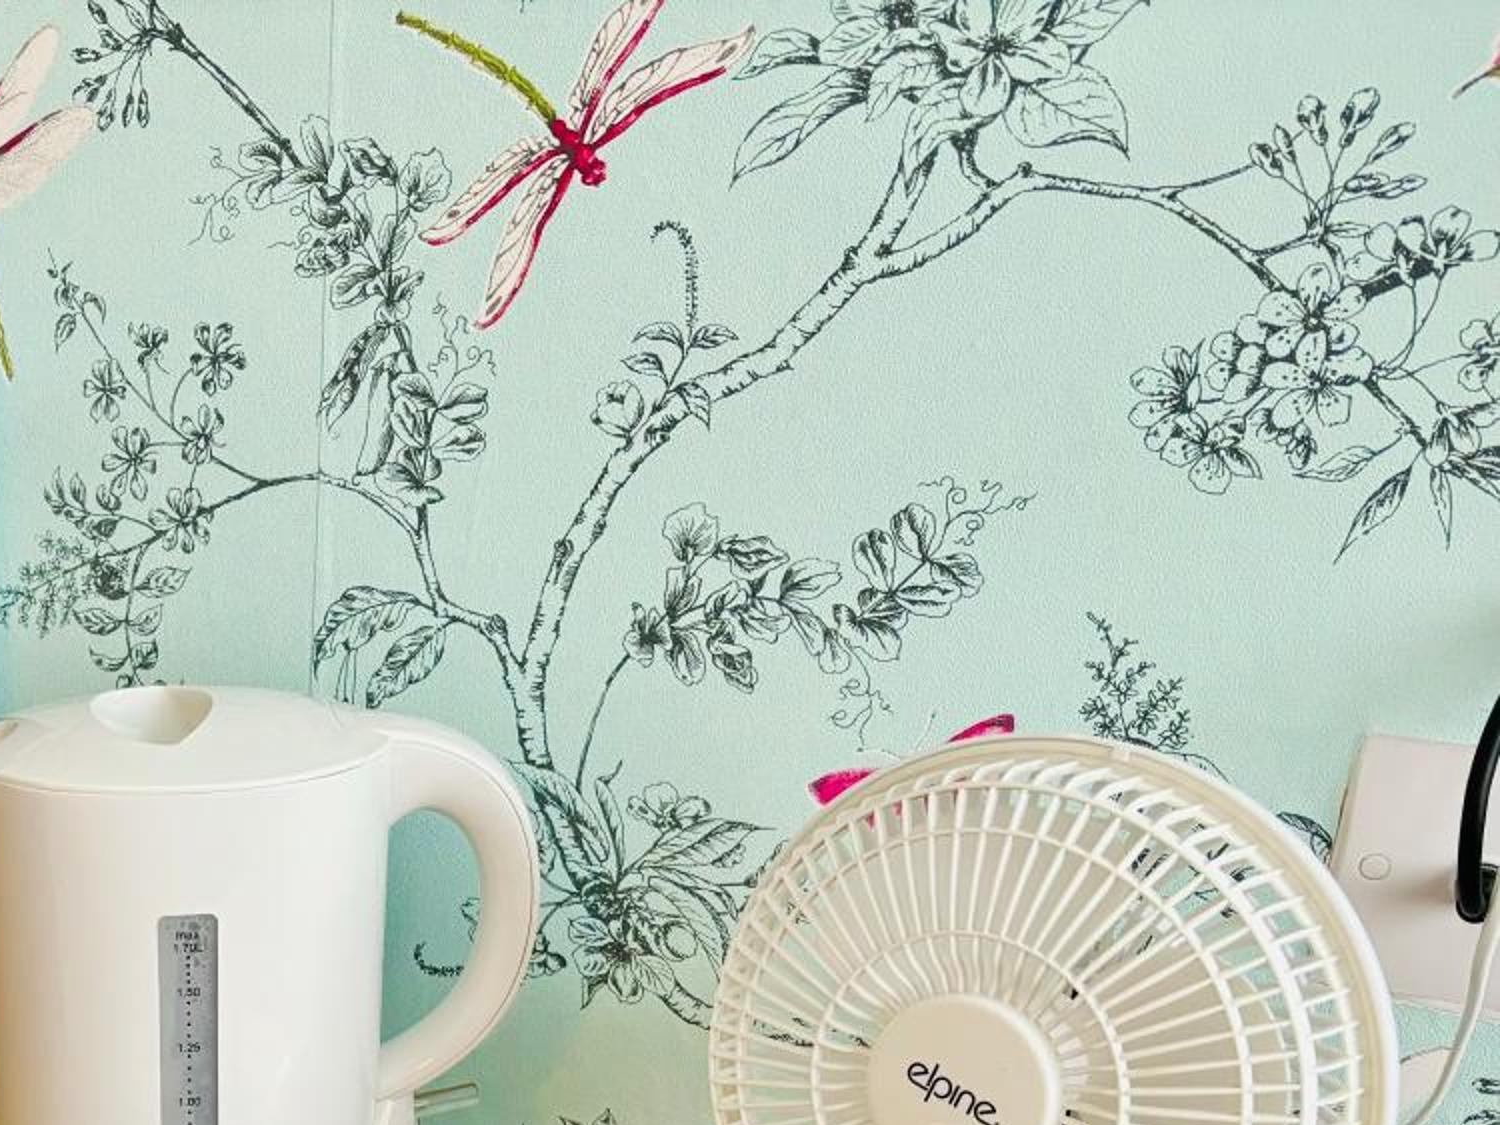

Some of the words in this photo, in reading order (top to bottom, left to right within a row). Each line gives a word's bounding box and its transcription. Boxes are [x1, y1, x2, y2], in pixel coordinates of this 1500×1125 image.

[177, 987, 201, 998] 1.50
[178, 1042, 201, 1053] 1.25
[179, 1096, 202, 1107] 1.00
